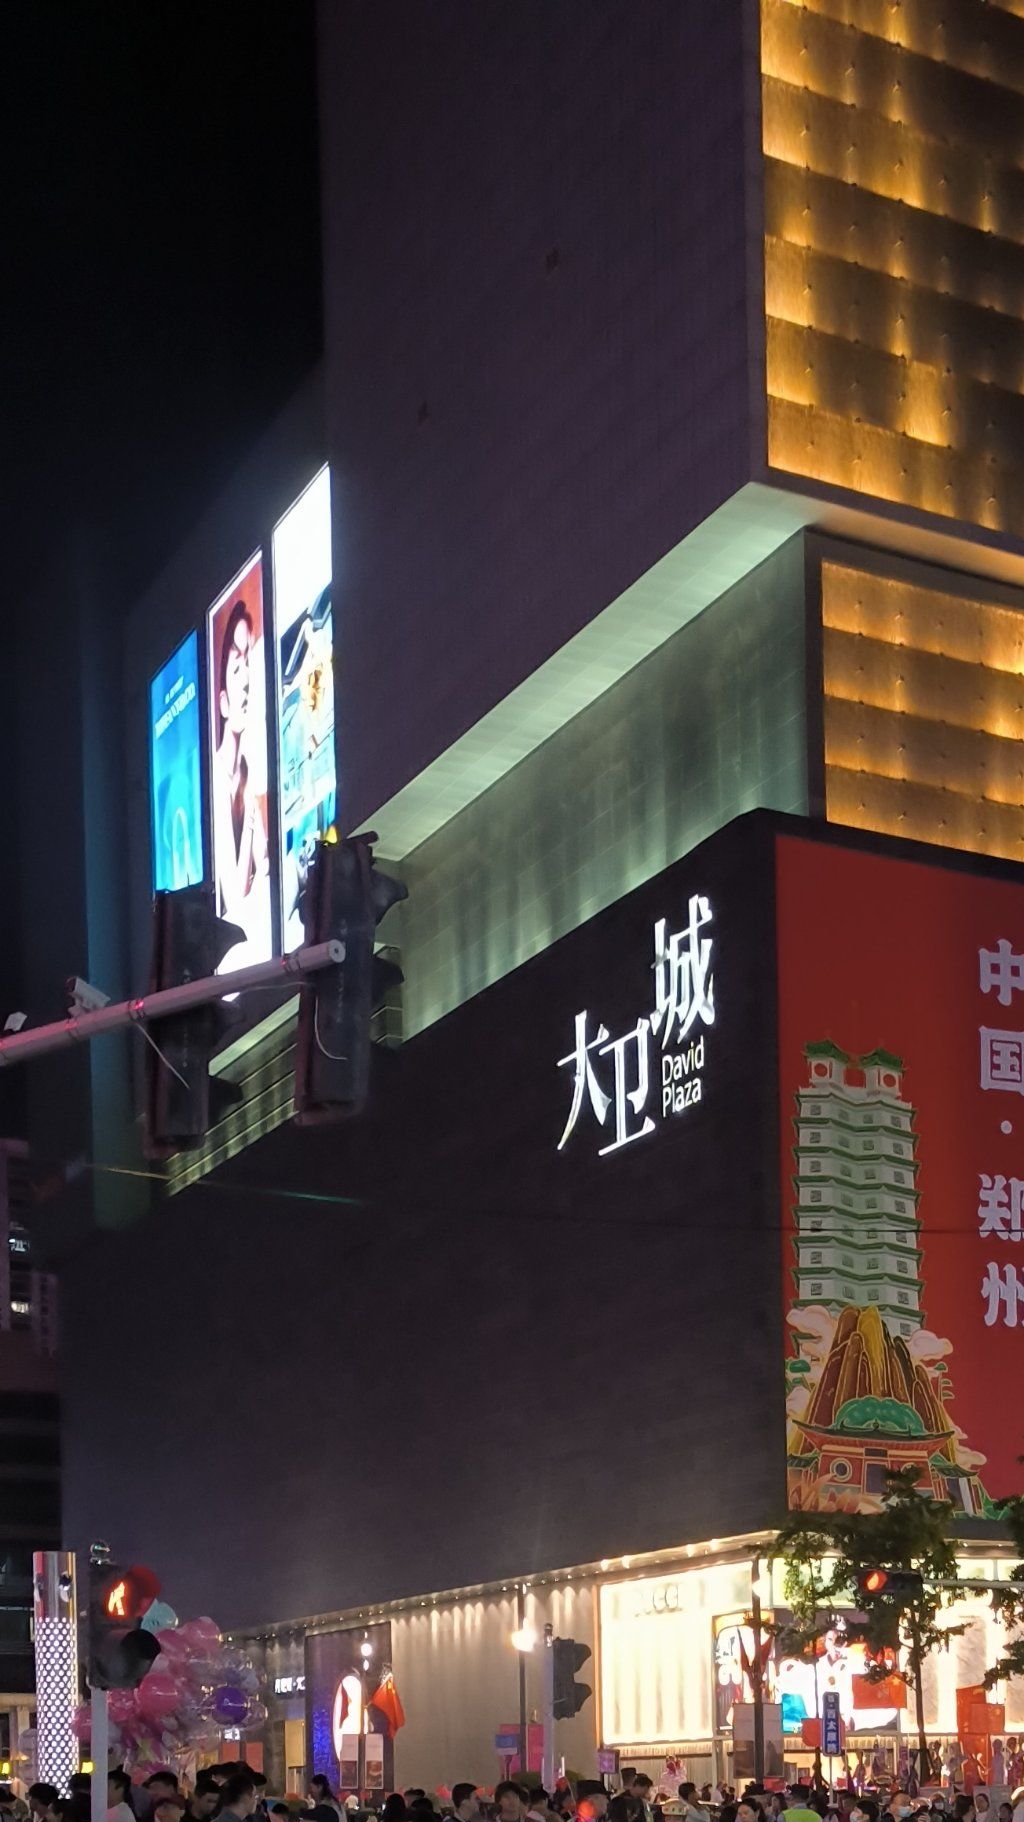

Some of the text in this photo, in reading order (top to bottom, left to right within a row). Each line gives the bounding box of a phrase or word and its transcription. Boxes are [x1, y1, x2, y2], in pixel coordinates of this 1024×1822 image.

[557, 893, 716, 1157] 大卫城
[662, 1035, 704, 1086] David
[662, 1077, 702, 1118] Plaza
